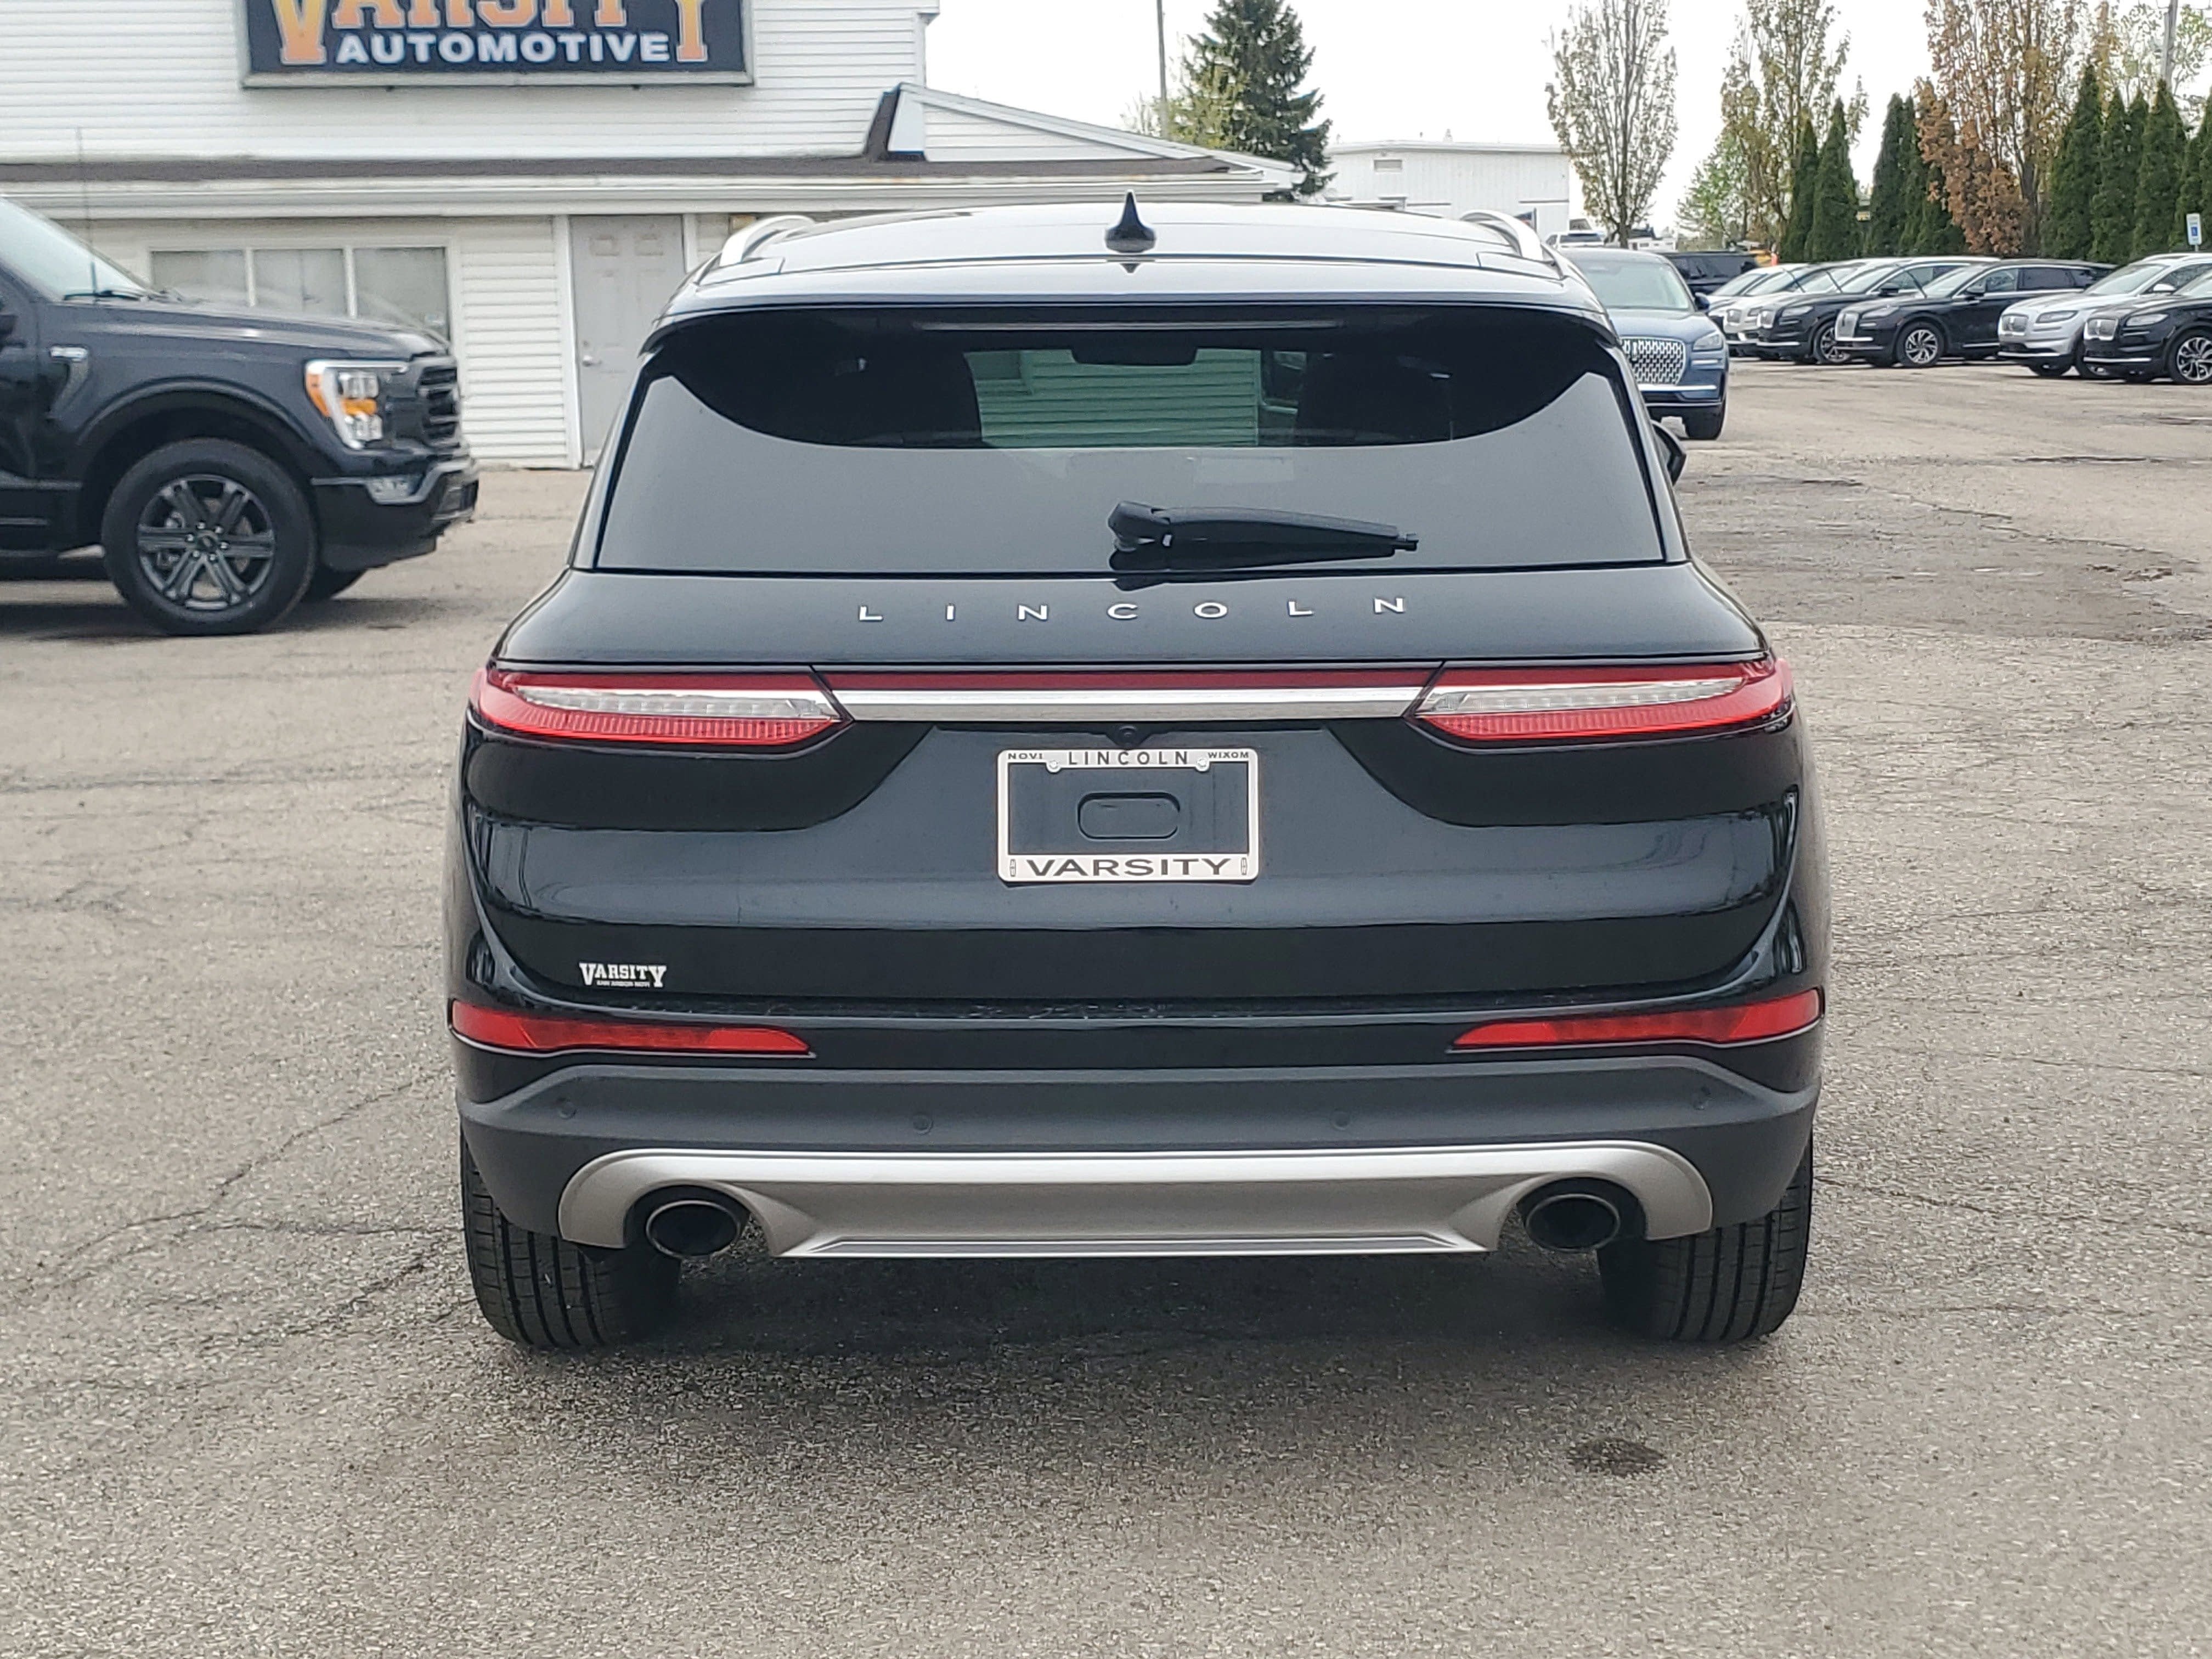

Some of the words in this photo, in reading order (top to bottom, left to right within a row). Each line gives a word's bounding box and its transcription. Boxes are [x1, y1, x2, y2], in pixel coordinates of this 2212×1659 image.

[335, 32, 670, 64] AUTOMOTIVE
[859, 598, 1404, 620] LINCOLN
[1069, 751, 1187, 765] LINCOLN
[1027, 859, 1231, 876] VARSITY
[579, 963, 667, 988] VARSITY
